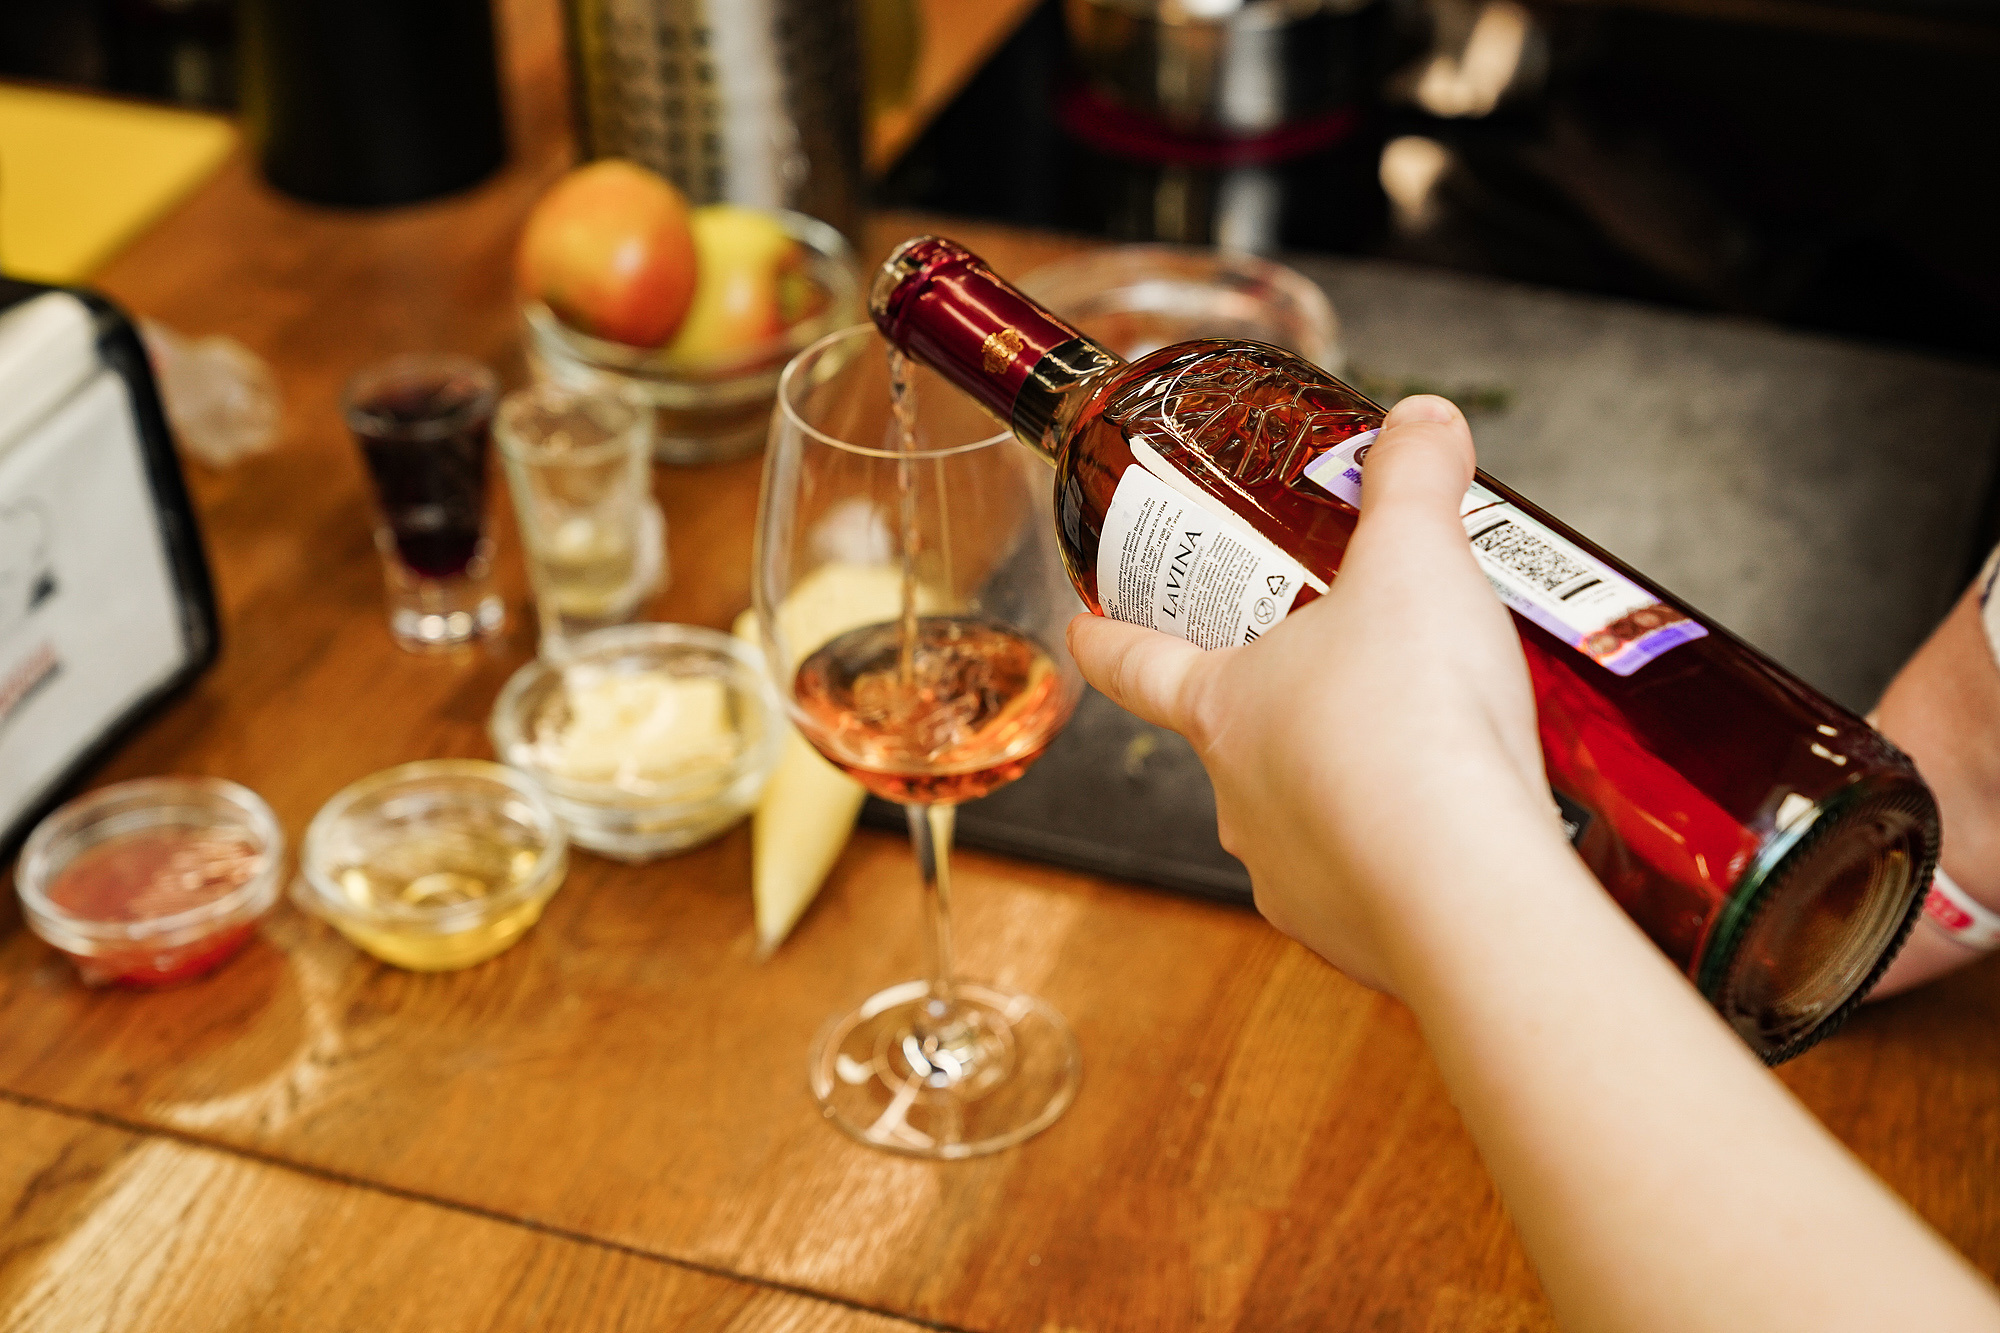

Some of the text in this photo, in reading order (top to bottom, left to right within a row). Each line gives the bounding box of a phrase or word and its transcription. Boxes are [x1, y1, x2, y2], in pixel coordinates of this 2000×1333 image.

[1138, 500, 1155, 536] различаются
[1154, 542, 1167, 574] помещение
[1195, 559, 1207, 584] 022/2011
[1178, 545, 1205, 615] Ценю настоящее.
